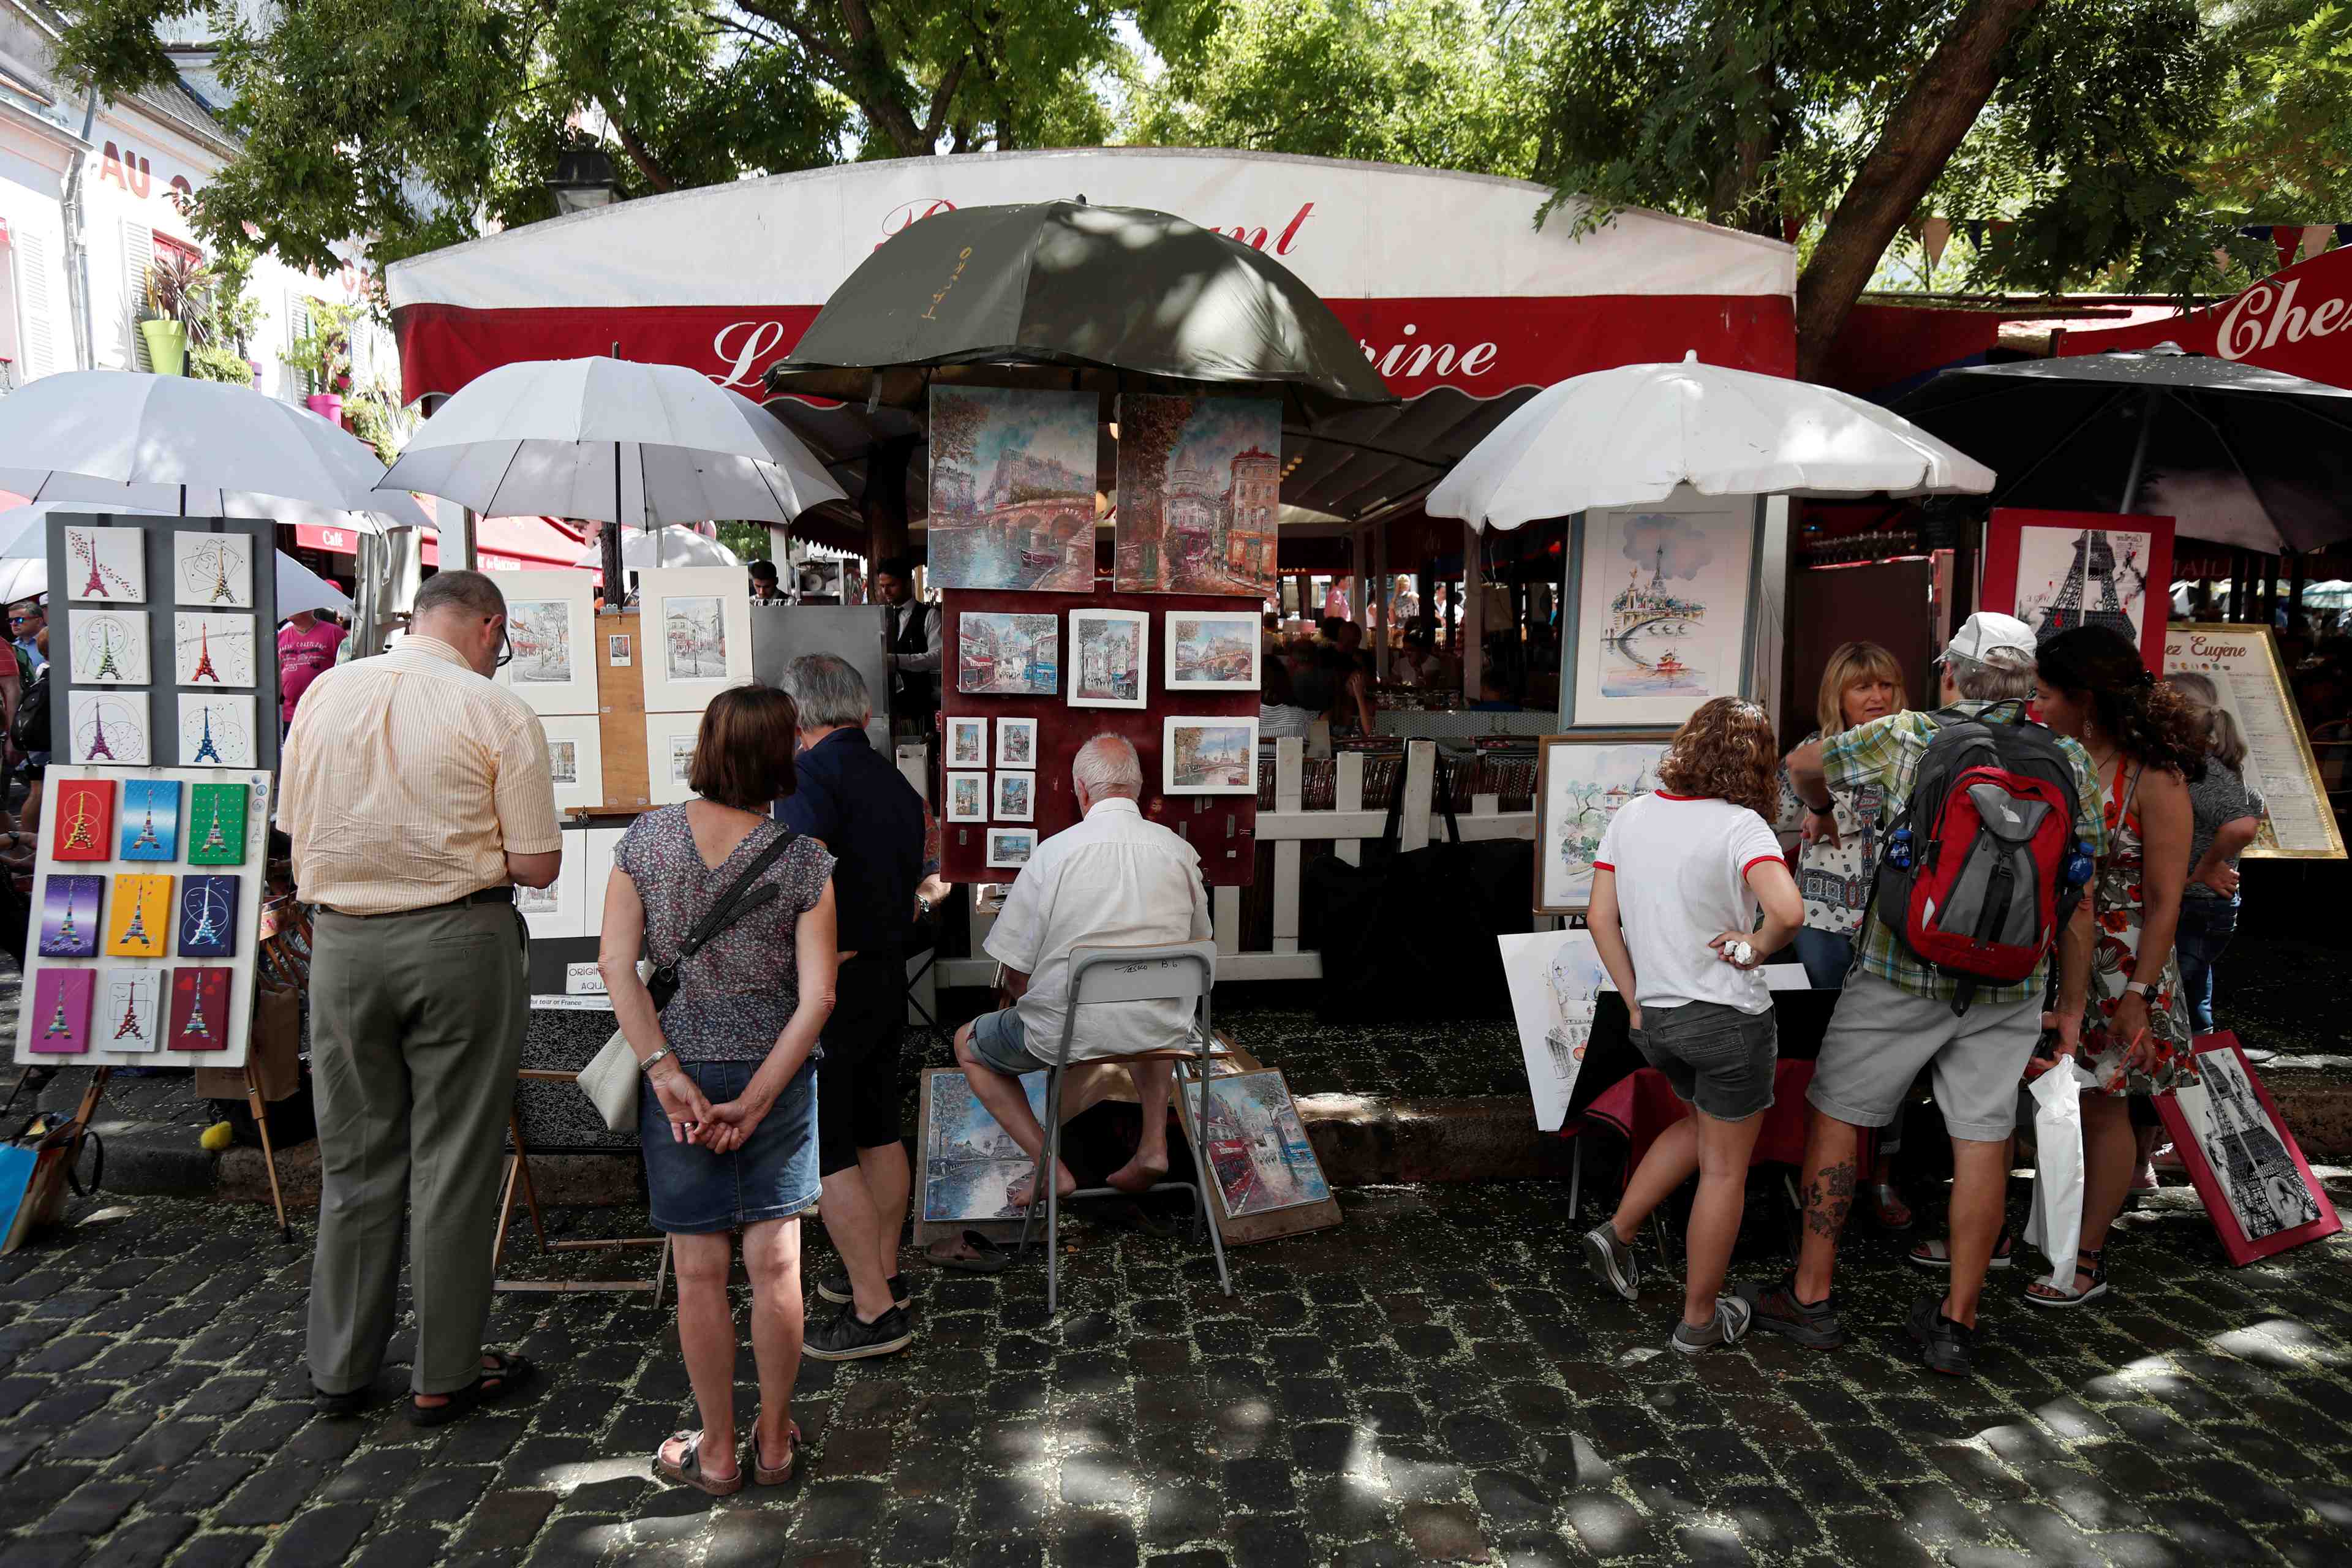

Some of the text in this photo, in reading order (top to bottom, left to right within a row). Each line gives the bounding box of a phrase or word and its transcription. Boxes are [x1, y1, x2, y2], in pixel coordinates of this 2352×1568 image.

[100, 140, 151, 199] AU
[323, 530, 344, 548] Café
[2165, 636, 2247, 662] ez Eugène
